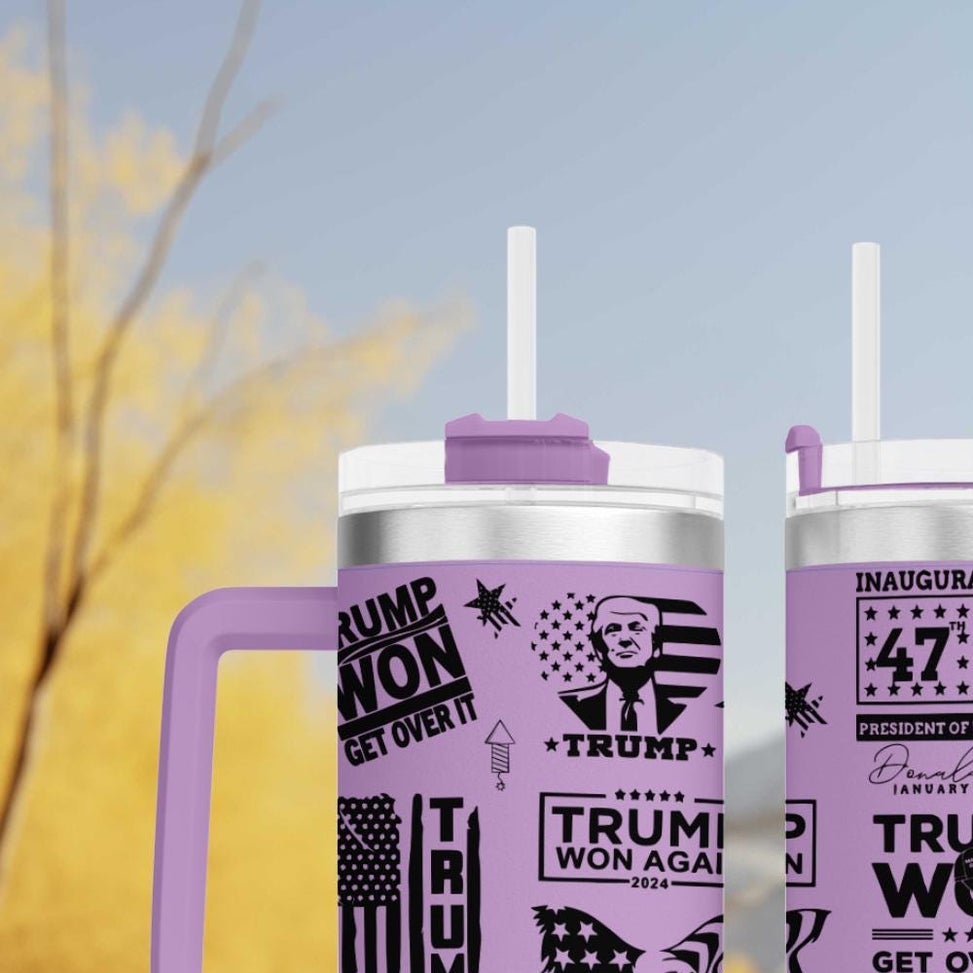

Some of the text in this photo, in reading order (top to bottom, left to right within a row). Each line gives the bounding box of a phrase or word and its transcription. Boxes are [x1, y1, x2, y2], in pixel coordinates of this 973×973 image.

[338, 624, 466, 721] WON
[344, 692, 478, 767] GET OVER IT
[859, 722, 946, 735] PRESIDENT
[949, 722, 969, 734] OF
[562, 734, 698, 760] TRUMP
[556, 846, 633, 870] WON
[631, 876, 669, 889] 2024
[872, 951, 933, 973] GET
